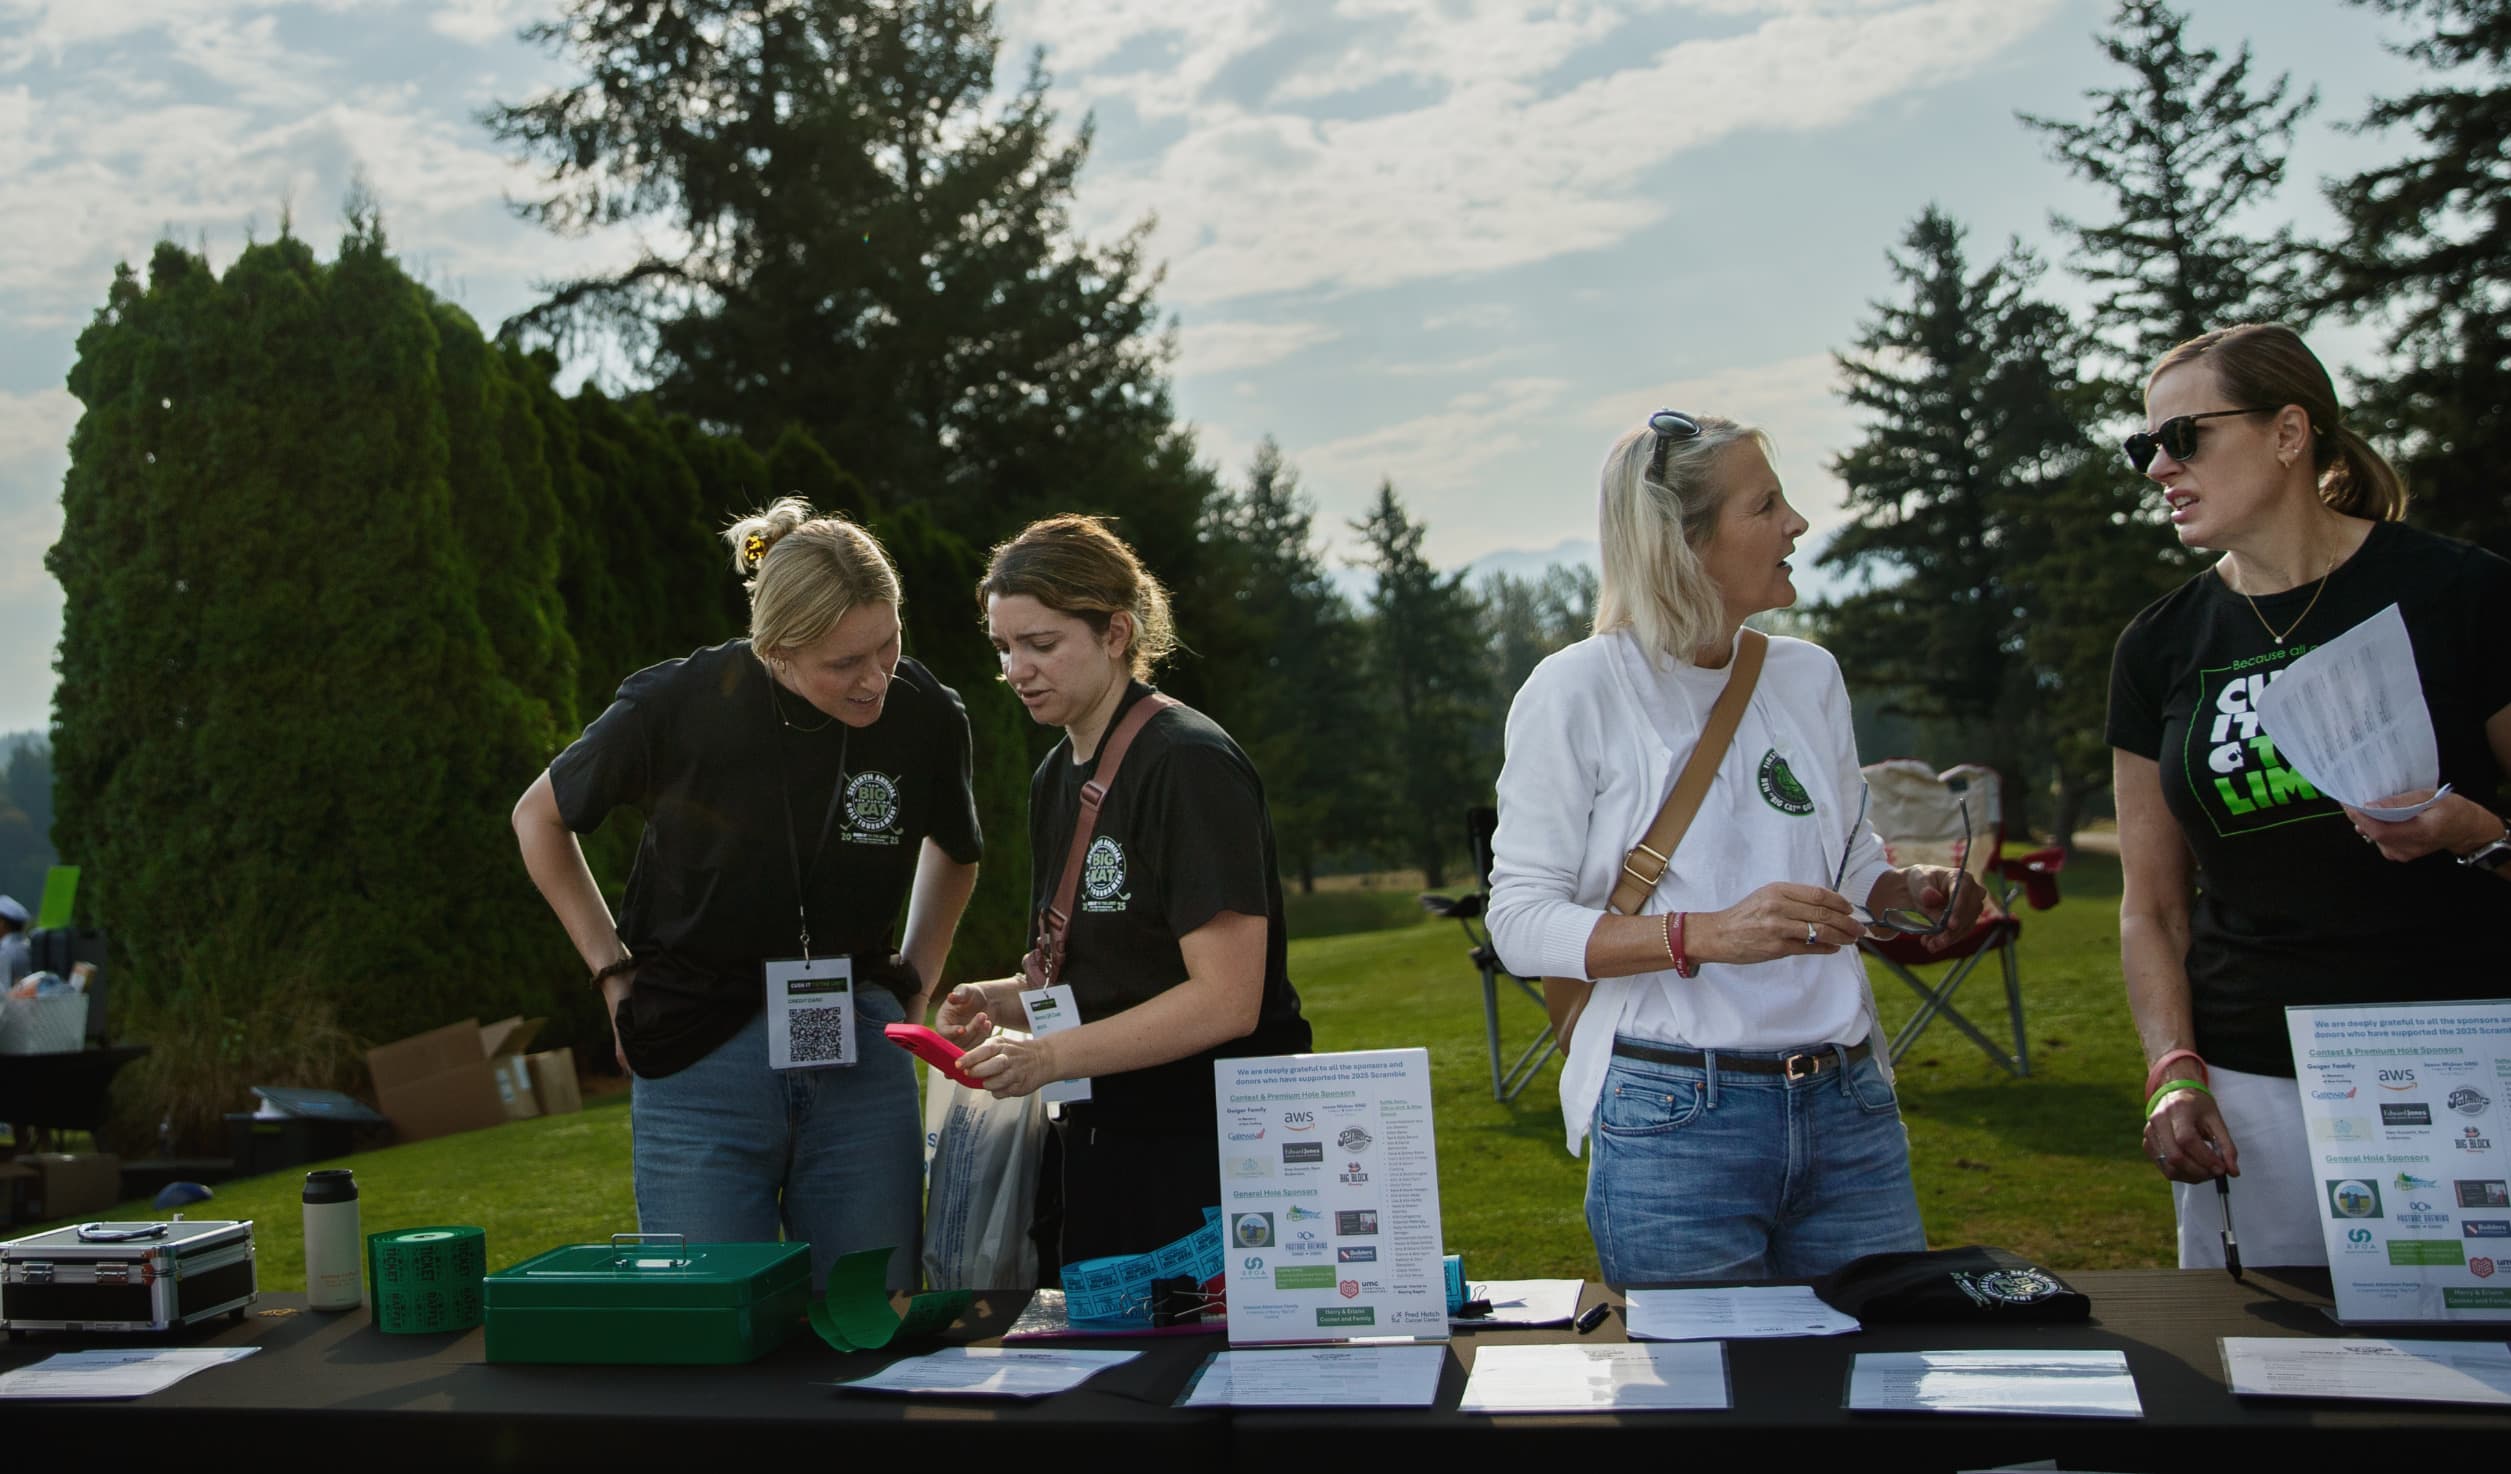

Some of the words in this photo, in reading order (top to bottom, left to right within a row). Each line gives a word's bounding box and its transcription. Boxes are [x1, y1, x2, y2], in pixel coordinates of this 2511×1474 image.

[2232, 648, 2286, 671] Because
[2289, 645, 2306, 656] all
[2216, 670, 2284, 714] CU
[875, 774, 897, 799] ANNUAL
[2213, 766, 2324, 816] LIM
[858, 786, 887, 801] BIG
[858, 806, 897, 830] TOURNAMENT
[1092, 853, 1115, 866] BIG
[2347, 1020, 2377, 1028] deeply
[2380, 1019, 2413, 1027] grateful
[2427, 1017, 2438, 1025] all
[2440, 1017, 2455, 1025] the
[2457, 1017, 2499, 1026] sponsors
[2391, 1028, 2437, 1037] supported
[2354, 1048, 2395, 1056] Premium
[2421, 1047, 2463, 1056] Sponsors
[1264, 1067, 1288, 1075] deeply
[1290, 1065, 1318, 1074] grateful
[1329, 1063, 1338, 1071] all
[1354, 1062, 1387, 1071] sponsors
[2379, 1068, 2415, 1081] aws
[1299, 1073, 1336, 1083] supported
[1302, 1090, 1319, 1098] Hole
[1321, 1090, 1355, 1098] Sponsors
[1284, 1111, 1313, 1123] aws
[2455, 1139, 2467, 1149] BIG
[2469, 1139, 2491, 1149] BLOCK
[2326, 1154, 2360, 1163] General
[2363, 1154, 2384, 1162] Hole
[2387, 1153, 2430, 1163] Sponsors
[1340, 1173, 1349, 1183] BIG
[1351, 1173, 1368, 1182] BLOCK
[1233, 1190, 1262, 1198] General
[1283, 1188, 1317, 1197] Sponsors
